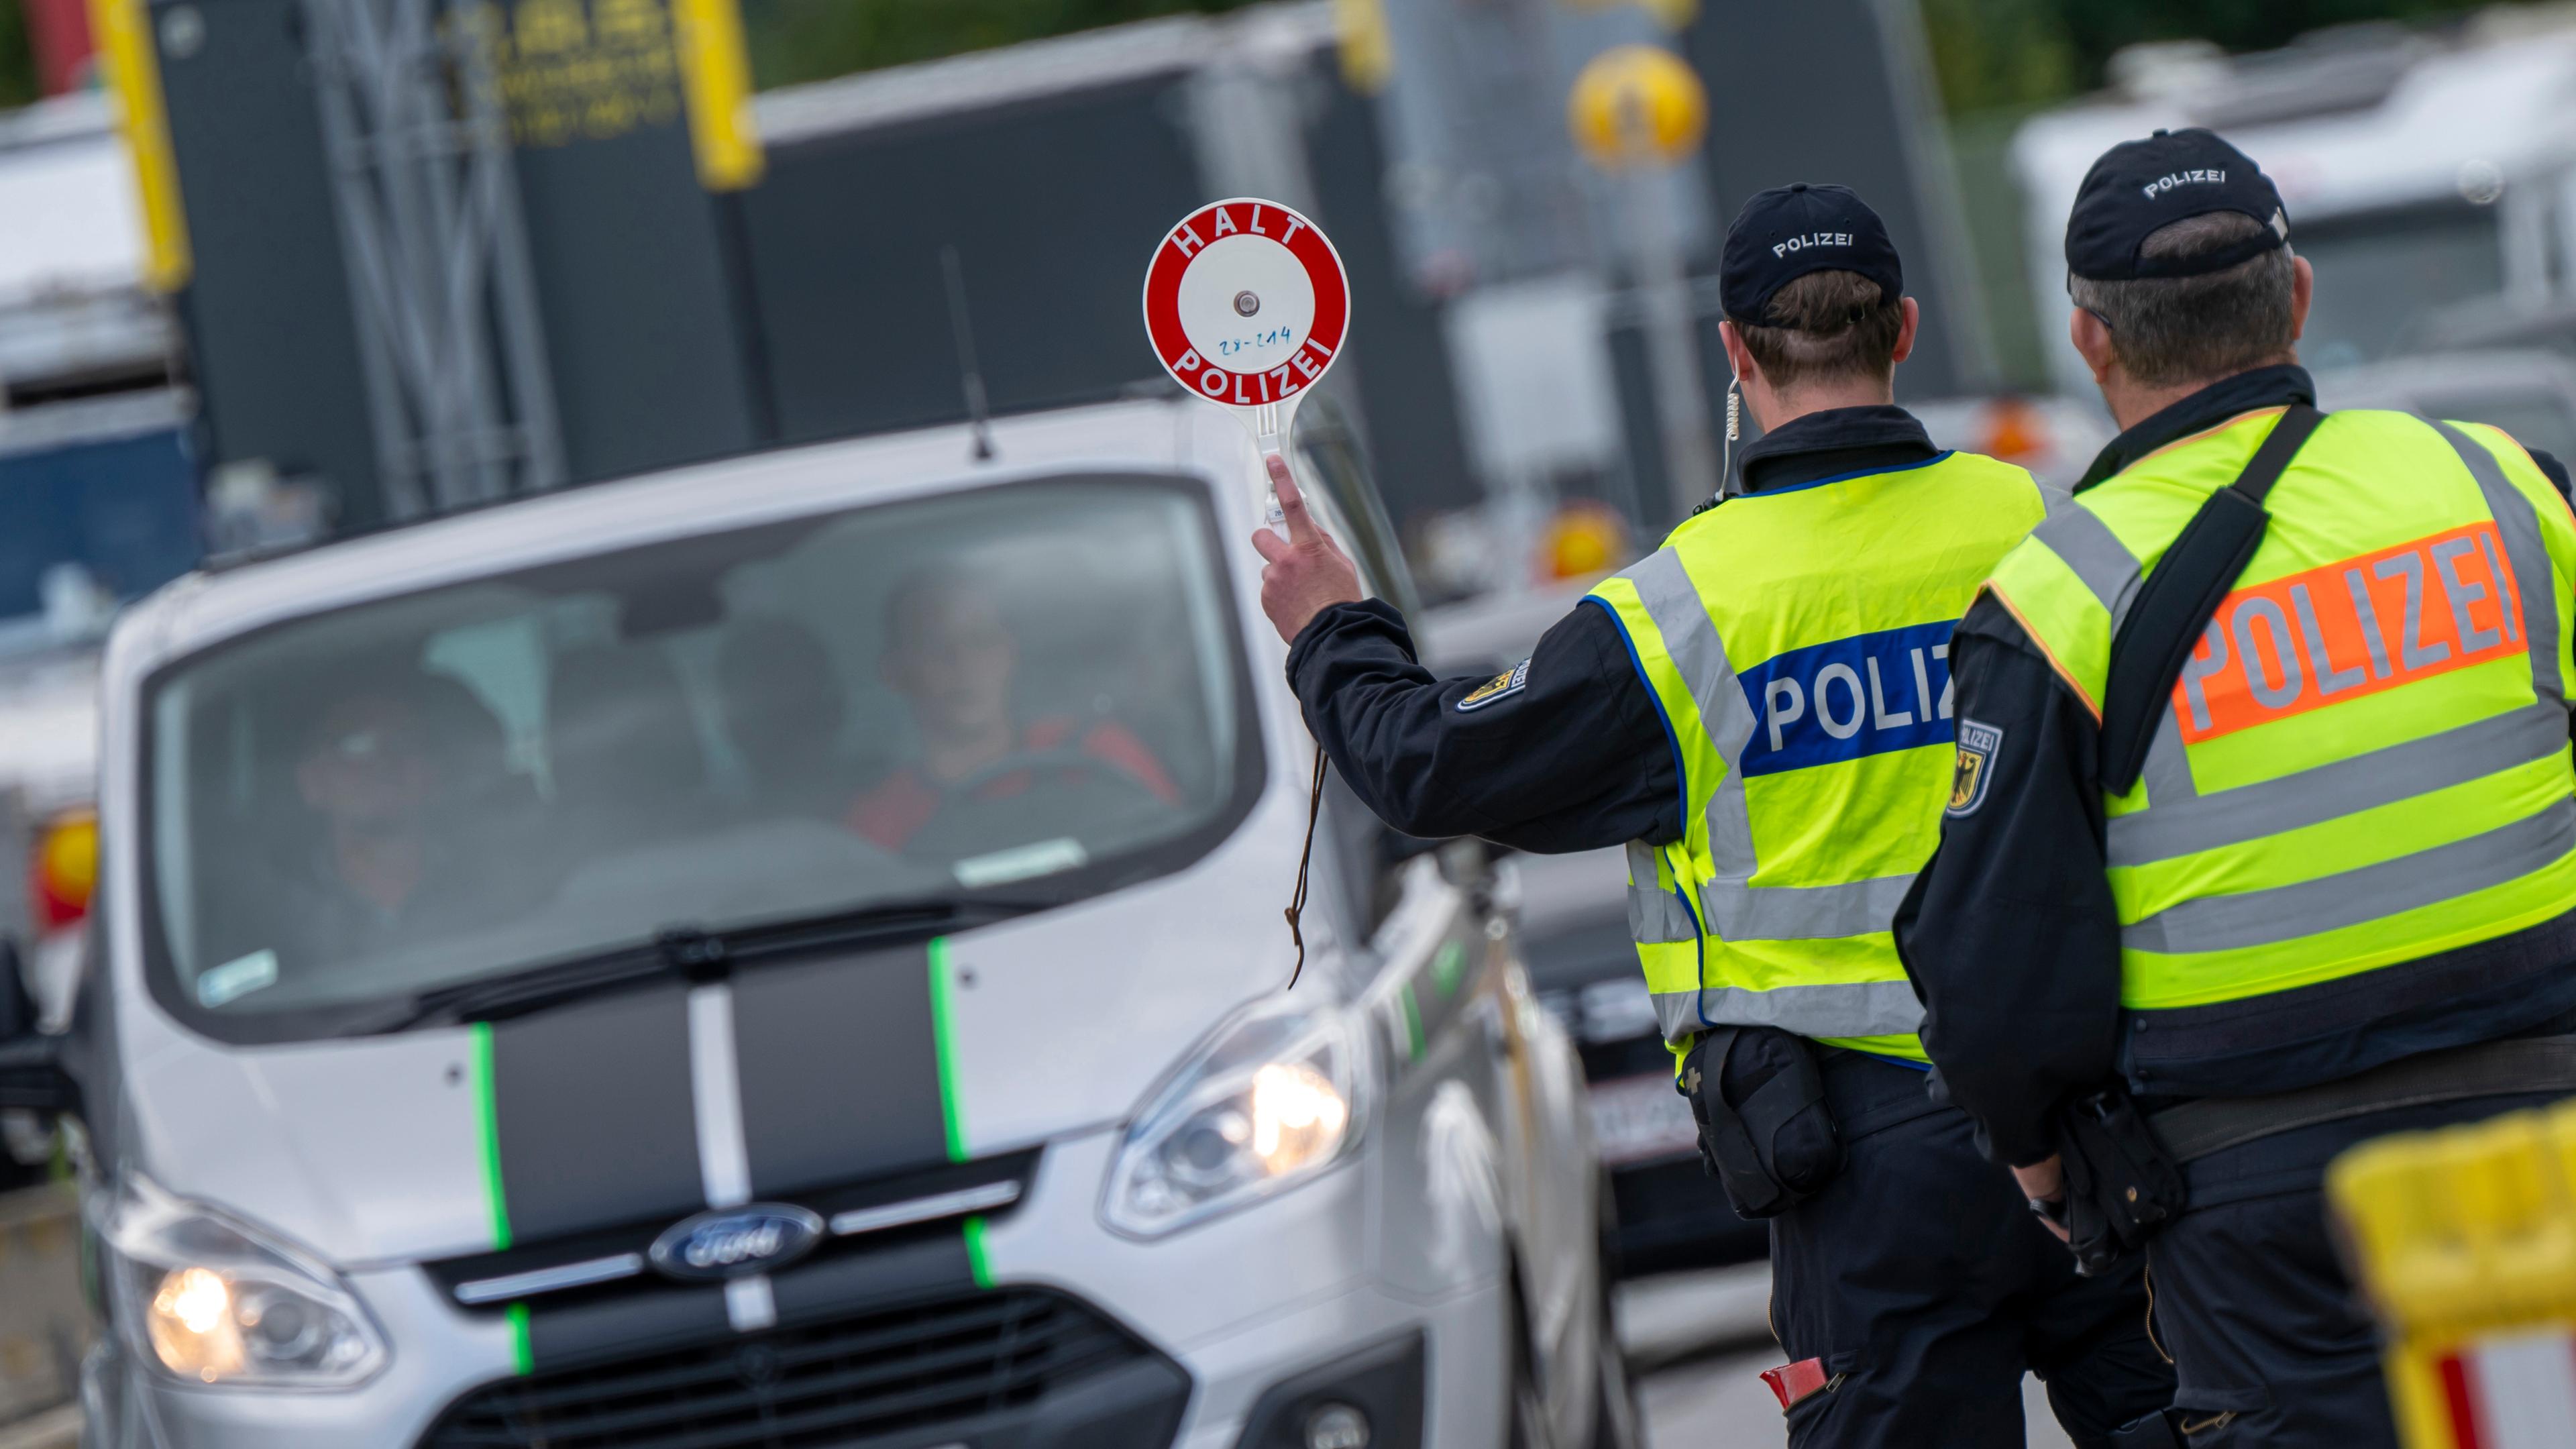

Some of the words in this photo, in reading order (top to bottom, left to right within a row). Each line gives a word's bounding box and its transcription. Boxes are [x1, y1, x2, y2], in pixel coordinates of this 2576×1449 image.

[2143, 169, 2226, 199] POLIZEI
[1171, 204, 1305, 258] HALT
[1772, 233, 1854, 258] POLIZEI
[1172, 337, 1332, 403] POLIZEI
[2181, 532, 2519, 732] POLIZEI
